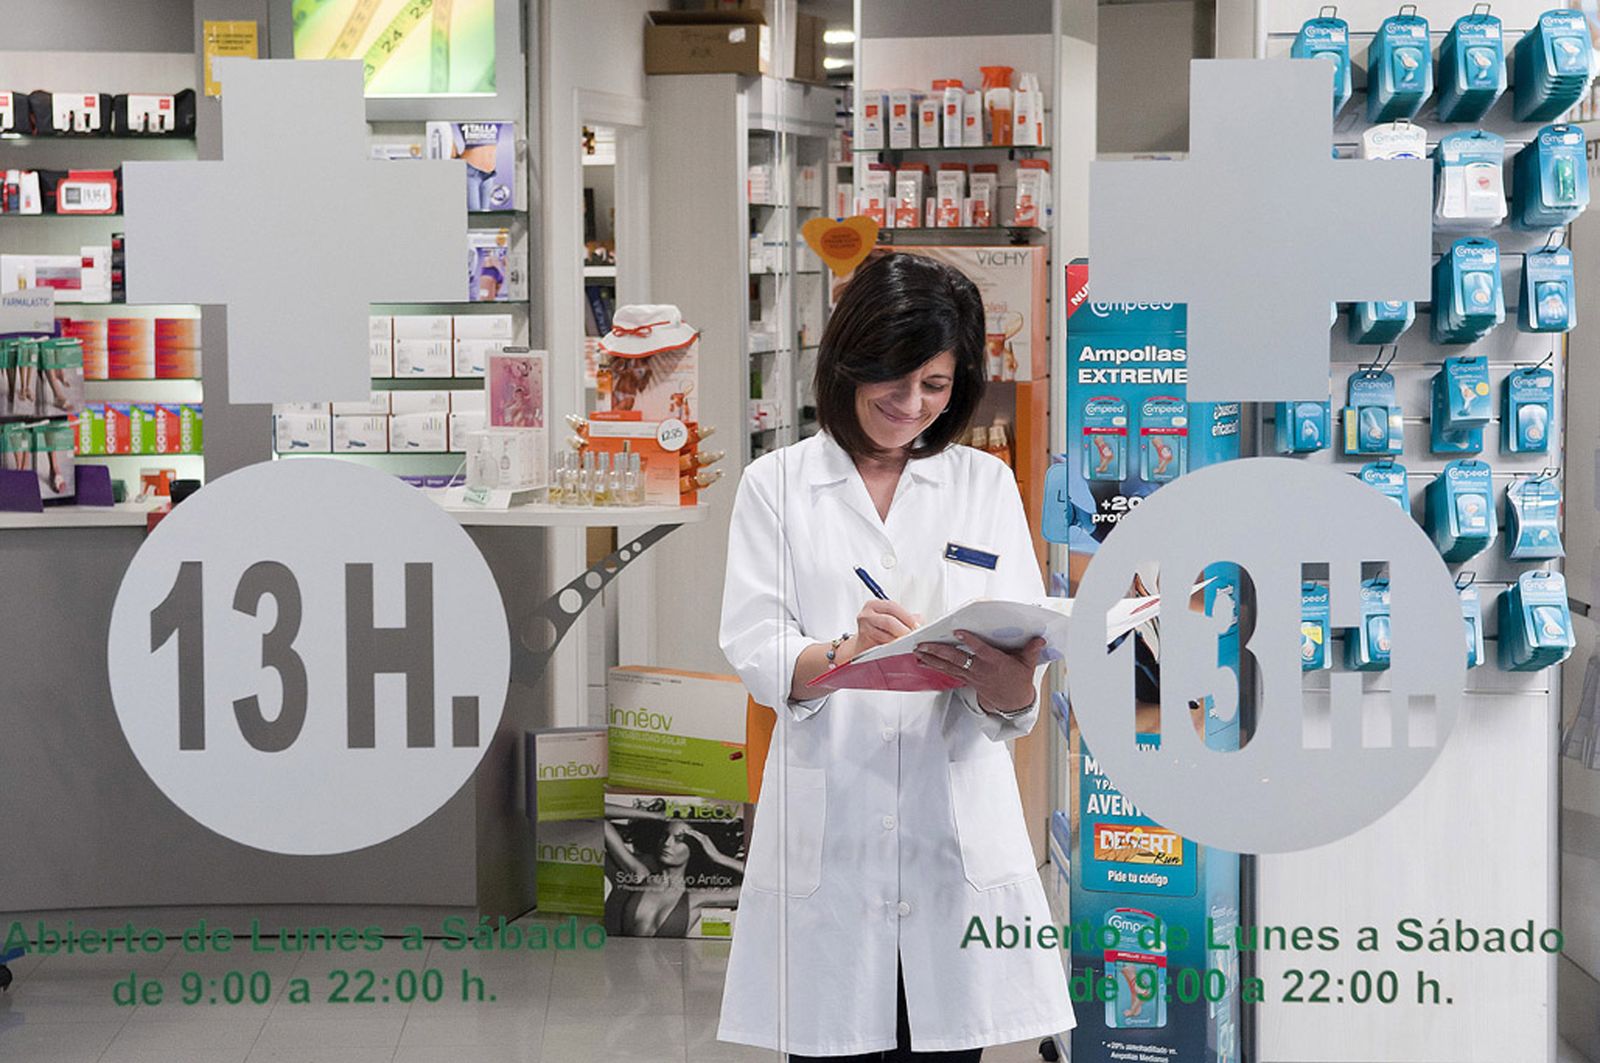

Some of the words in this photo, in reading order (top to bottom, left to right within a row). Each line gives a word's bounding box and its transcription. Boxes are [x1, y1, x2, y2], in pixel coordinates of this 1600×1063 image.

[976, 251, 1029, 266] VICHY
[1079, 346, 1187, 365] Ampollas
[1078, 368, 1188, 384] EXTREME
[1448, 467, 1490, 479] Compeed
[1101, 495, 1145, 511] +20
[1092, 513, 1127, 524] prot
[1302, 592, 1328, 604] peed
[150, 560, 308, 753] 13
[345, 562, 480, 749] H.
[1107, 560, 1264, 753] 13
[1100, 830, 1177, 854] DESERT
[1153, 852, 1181, 865] Run
[1107, 870, 1126, 882] Pide
[1128, 873, 1137, 884] tu
[1138, 872, 1168, 888] código
[2, 920, 165, 956] Abierto
[182, 919, 233, 954] de
[251, 917, 385, 954] Lunes
[402, 925, 425, 952] a
[441, 916, 607, 953] Sábado
[960, 916, 1121, 951] Abierto
[1138, 916, 1189, 950] de
[1208, 917, 1340, 952] Lunes
[1356, 924, 1381, 952] a
[1398, 917, 1566, 954] Sábado
[112, 971, 163, 1006] de
[180, 971, 272, 1006] 9:00
[289, 979, 311, 1004] a
[327, 969, 444, 1005] 22:00
[461, 968, 498, 1003] h.
[1070, 967, 1119, 1003] de
[1136, 968, 1225, 1004] 9:00
[1242, 976, 1265, 1004] a
[1282, 970, 1400, 1005] 22:00
[1416, 969, 1455, 1005] h.
